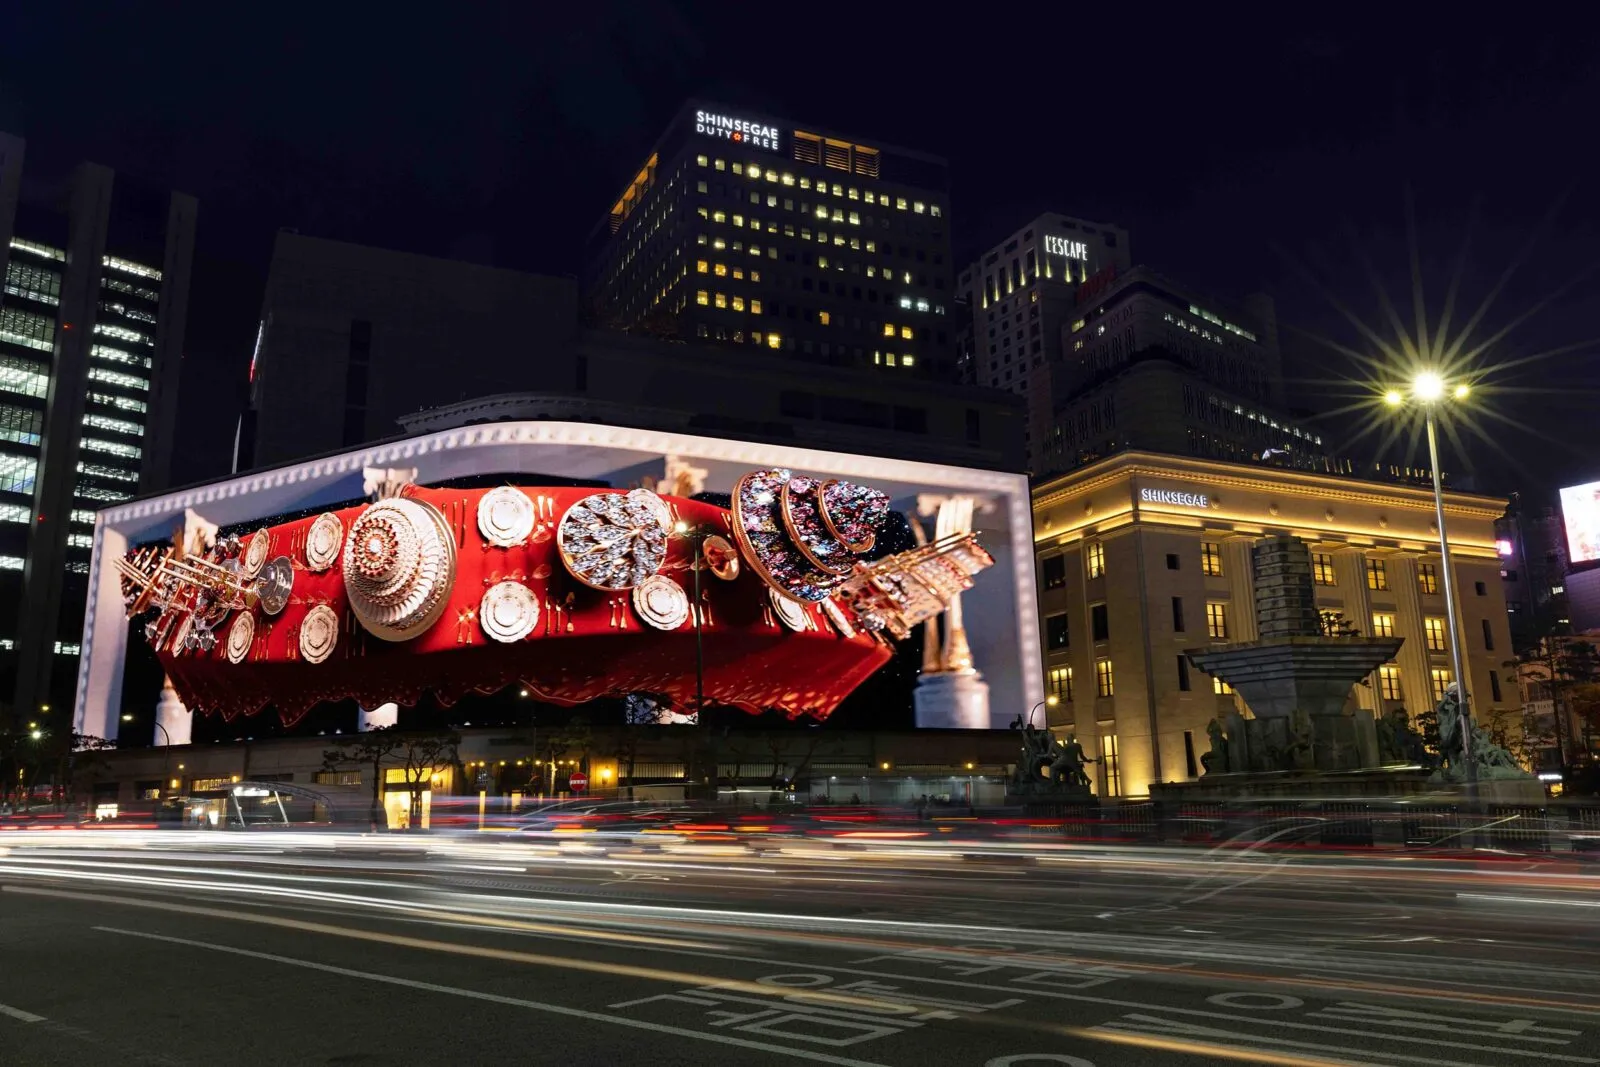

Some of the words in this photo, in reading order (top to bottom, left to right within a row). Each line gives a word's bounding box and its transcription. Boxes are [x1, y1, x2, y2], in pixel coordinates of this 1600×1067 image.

[696, 110, 779, 140] SHINSEGAE
[696, 123, 732, 139] DUTY
[743, 134, 779, 150] FREE
[1044, 234, 1088, 261] L'ESCAPE
[1141, 488, 1208, 508] SHINSEGAE
